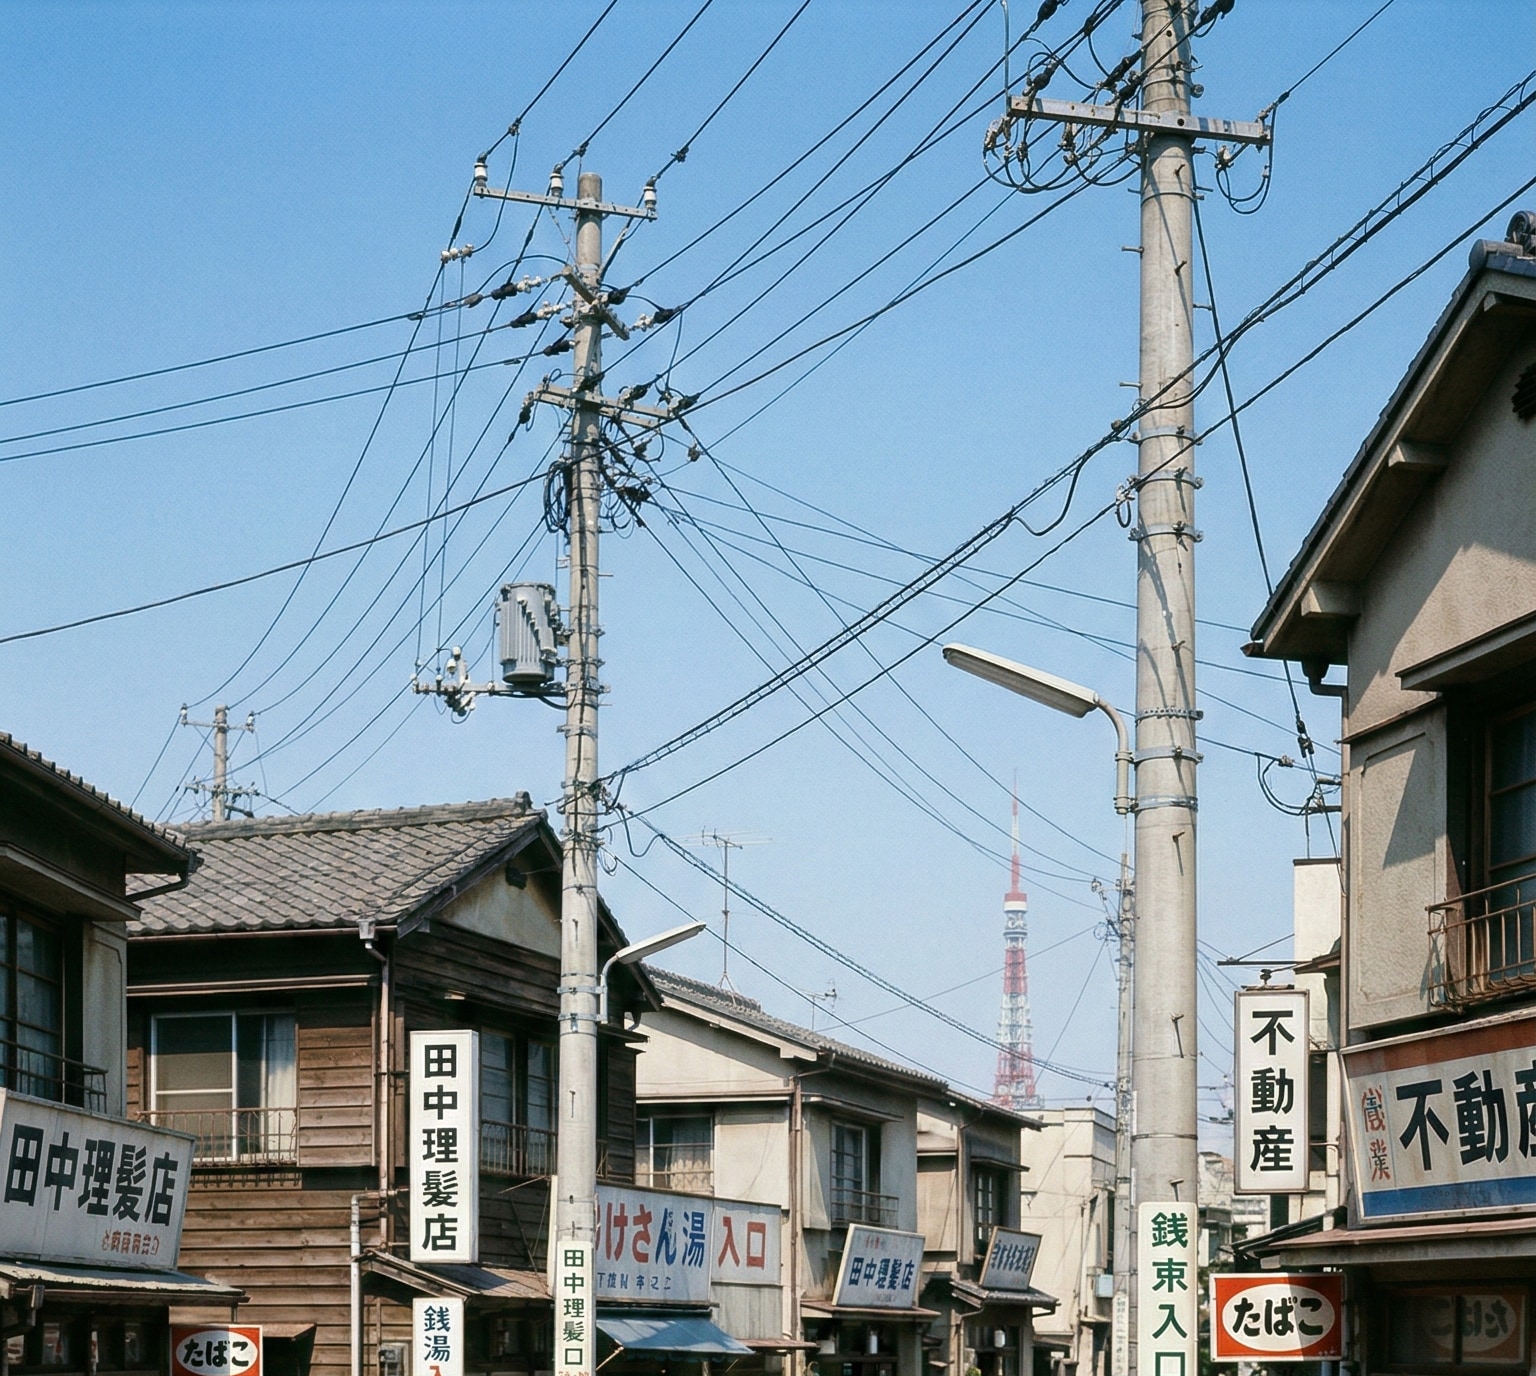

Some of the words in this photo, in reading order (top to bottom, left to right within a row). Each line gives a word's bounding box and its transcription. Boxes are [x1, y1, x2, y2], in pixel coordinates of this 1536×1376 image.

[1250, 1010, 1295, 1172] 不動産
[4, 1123, 178, 1227] 田中理髪店
[422, 1043, 459, 1251] 田中理髪店
[595, 1202, 706, 1268] けさん湯
[718, 1216, 766, 1270] 入口
[183, 1338, 249, 1368] たばこ
[1232, 1297, 1324, 1337] たばこ
